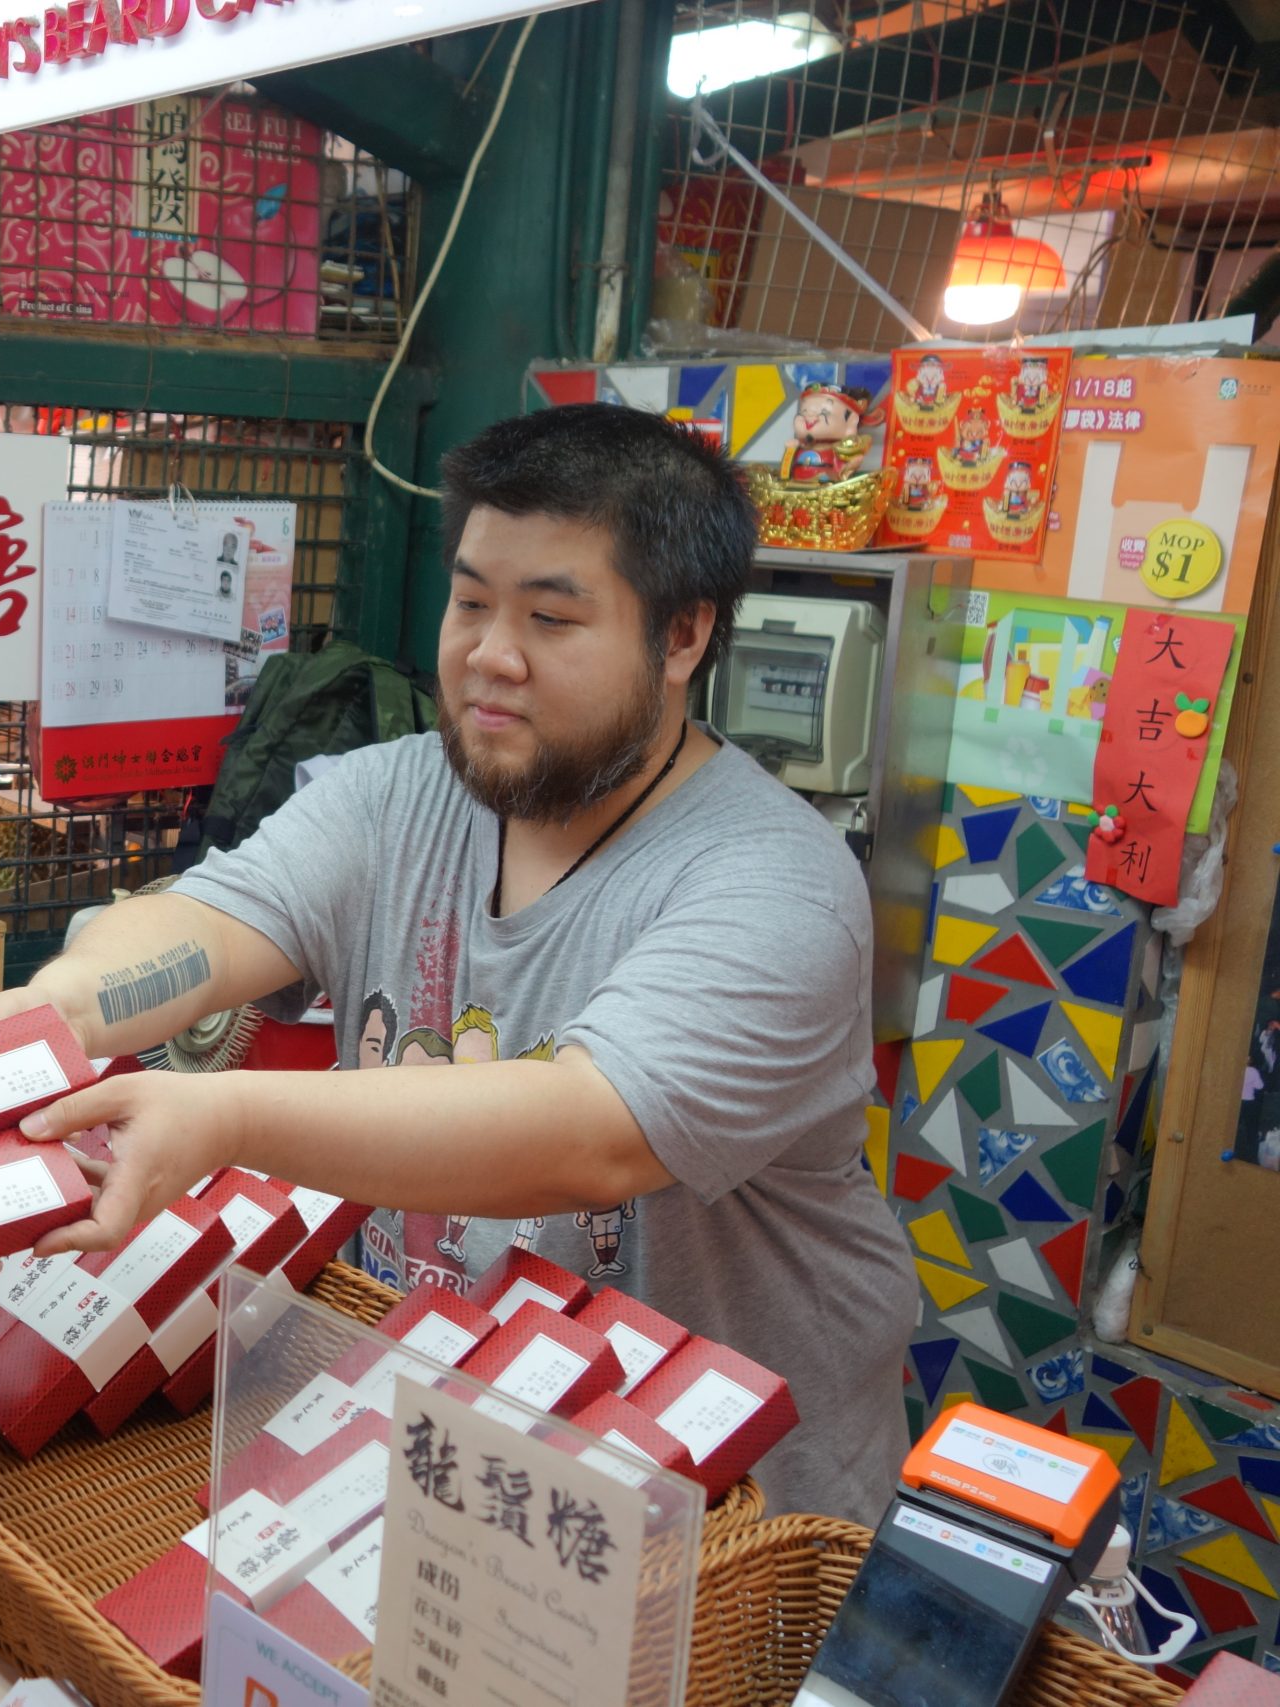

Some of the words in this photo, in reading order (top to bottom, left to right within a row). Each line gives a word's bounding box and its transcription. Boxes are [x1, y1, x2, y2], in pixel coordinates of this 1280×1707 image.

[44, 0, 190, 64] BEARD
[263, 116, 302, 139] FUI
[145, 100, 188, 226] 鴻發
[242, 140, 301, 164] APPLE
[21, 300, 55, 312] Prouct
[66, 304, 93, 314] Cina
[1074, 378, 1133, 398] 1/18起
[1062, 408, 1141, 430] 膠袋》法律
[1160, 531, 1206, 552] MOP
[1151, 549, 1193, 584] $1
[66, 606, 76, 621] 14
[91, 606, 102, 621] 15
[1119, 627, 1187, 884] 大吉大利
[62, 1295, 111, 1345] 龍鬚糖
[402, 1411, 619, 1586] 龍鬚糖
[236, 1527, 302, 1578] 龍鬚糖
[407, 1509, 480, 1569] Dragon's
[417, 1558, 461, 1601] 成份
[256, 1637, 278, 1667] WE
[280, 1659, 344, 1705] ACCEPT
